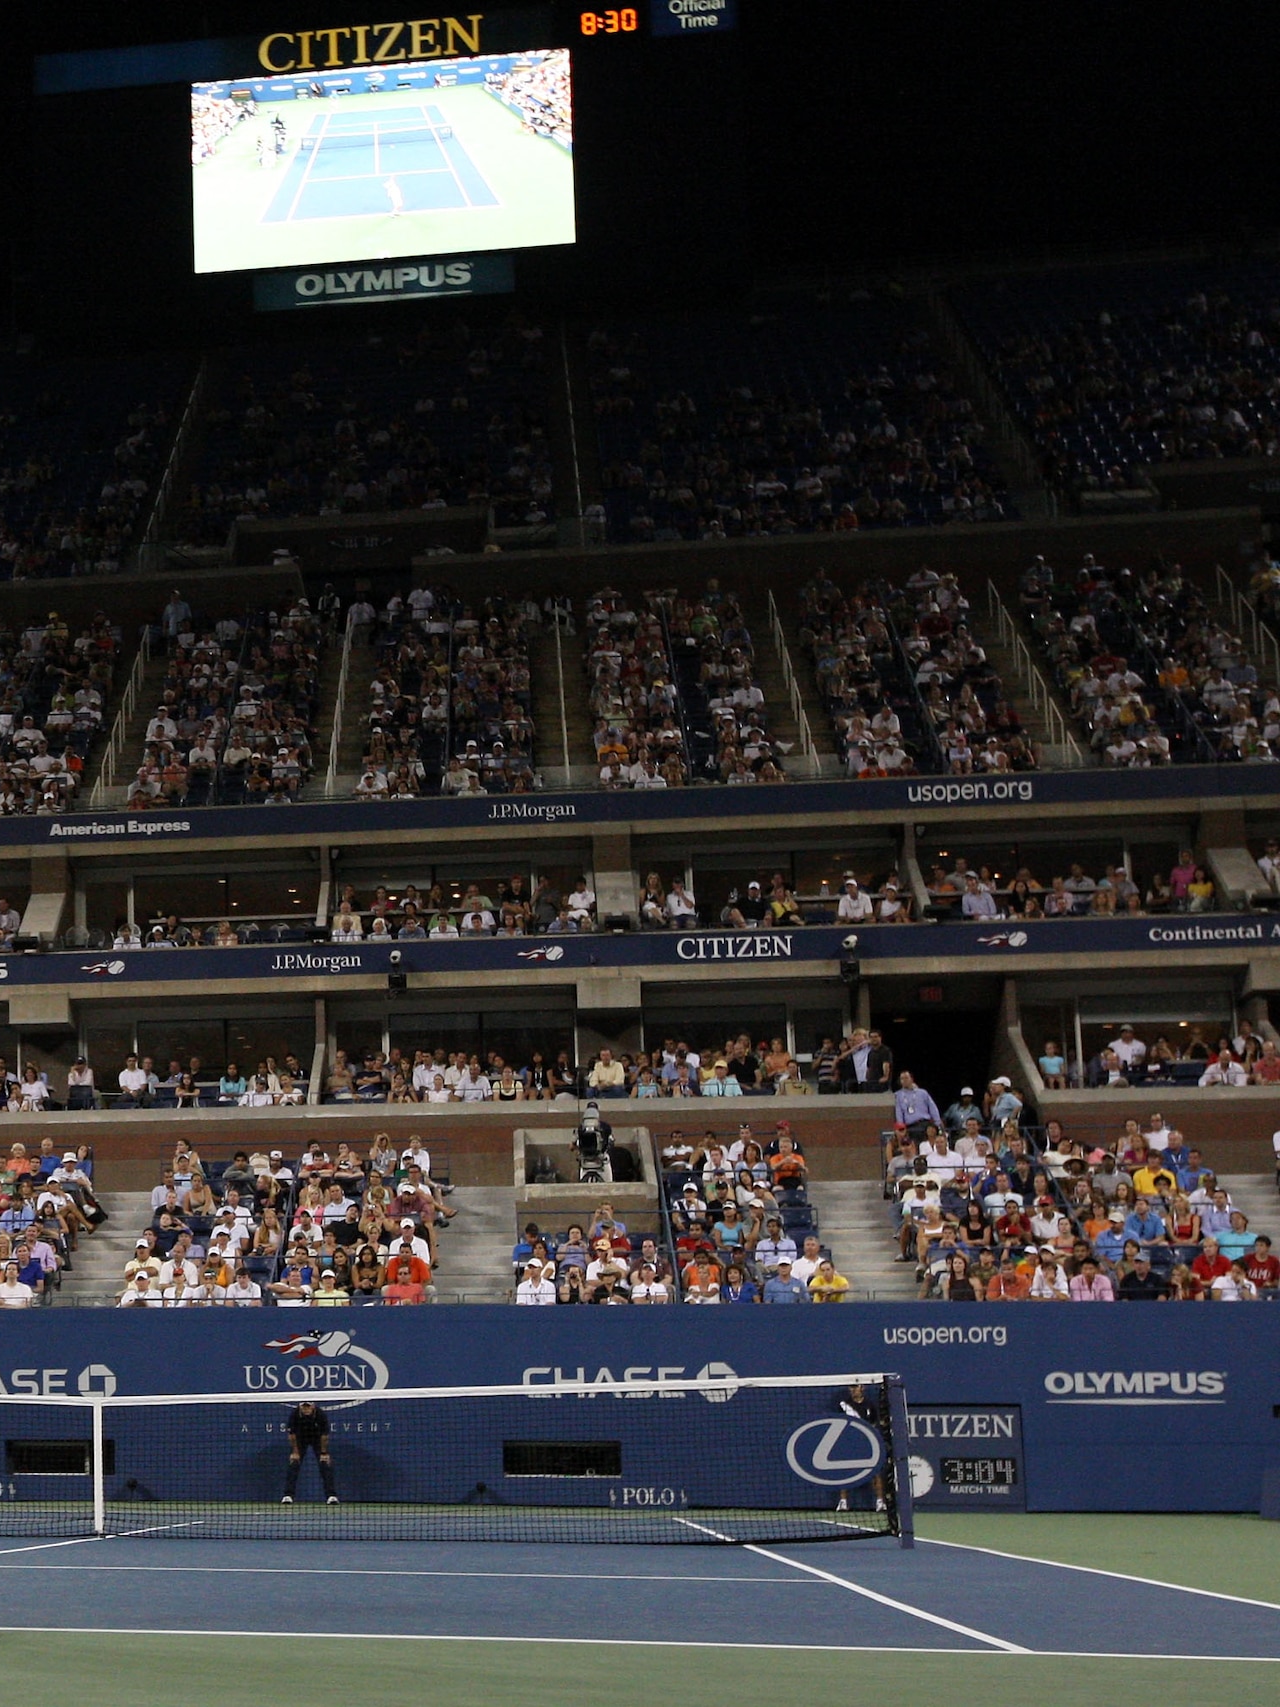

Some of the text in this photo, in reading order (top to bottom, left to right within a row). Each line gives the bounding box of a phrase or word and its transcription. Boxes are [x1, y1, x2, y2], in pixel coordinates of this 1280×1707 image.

[581, 8, 637, 35] 8:30
[677, 14, 719, 29] Time
[258, 15, 483, 72] CITIZEN
[295, 262, 472, 297] OLYMPUS
[907, 781, 1033, 803] usopen.org
[488, 803, 577, 821] J.P.Morgan
[49, 820, 191, 836] American Express
[1148, 924, 1263, 942] Continental
[676, 935, 793, 960] CITIZEN
[271, 953, 362, 973] J.P.Morgan
[883, 1326, 1007, 1346] usopen.org
[243, 1365, 367, 1389] US OPEN
[522, 1367, 686, 1398] CHASE
[1044, 1371, 1225, 1395] OLYMPUS
[907, 1414, 1014, 1438] ITIZEN
[944, 1460, 1015, 1484] 3:04
[622, 1487, 675, 1505] POLO
[950, 1486, 1009, 1494] MATCH TIME
